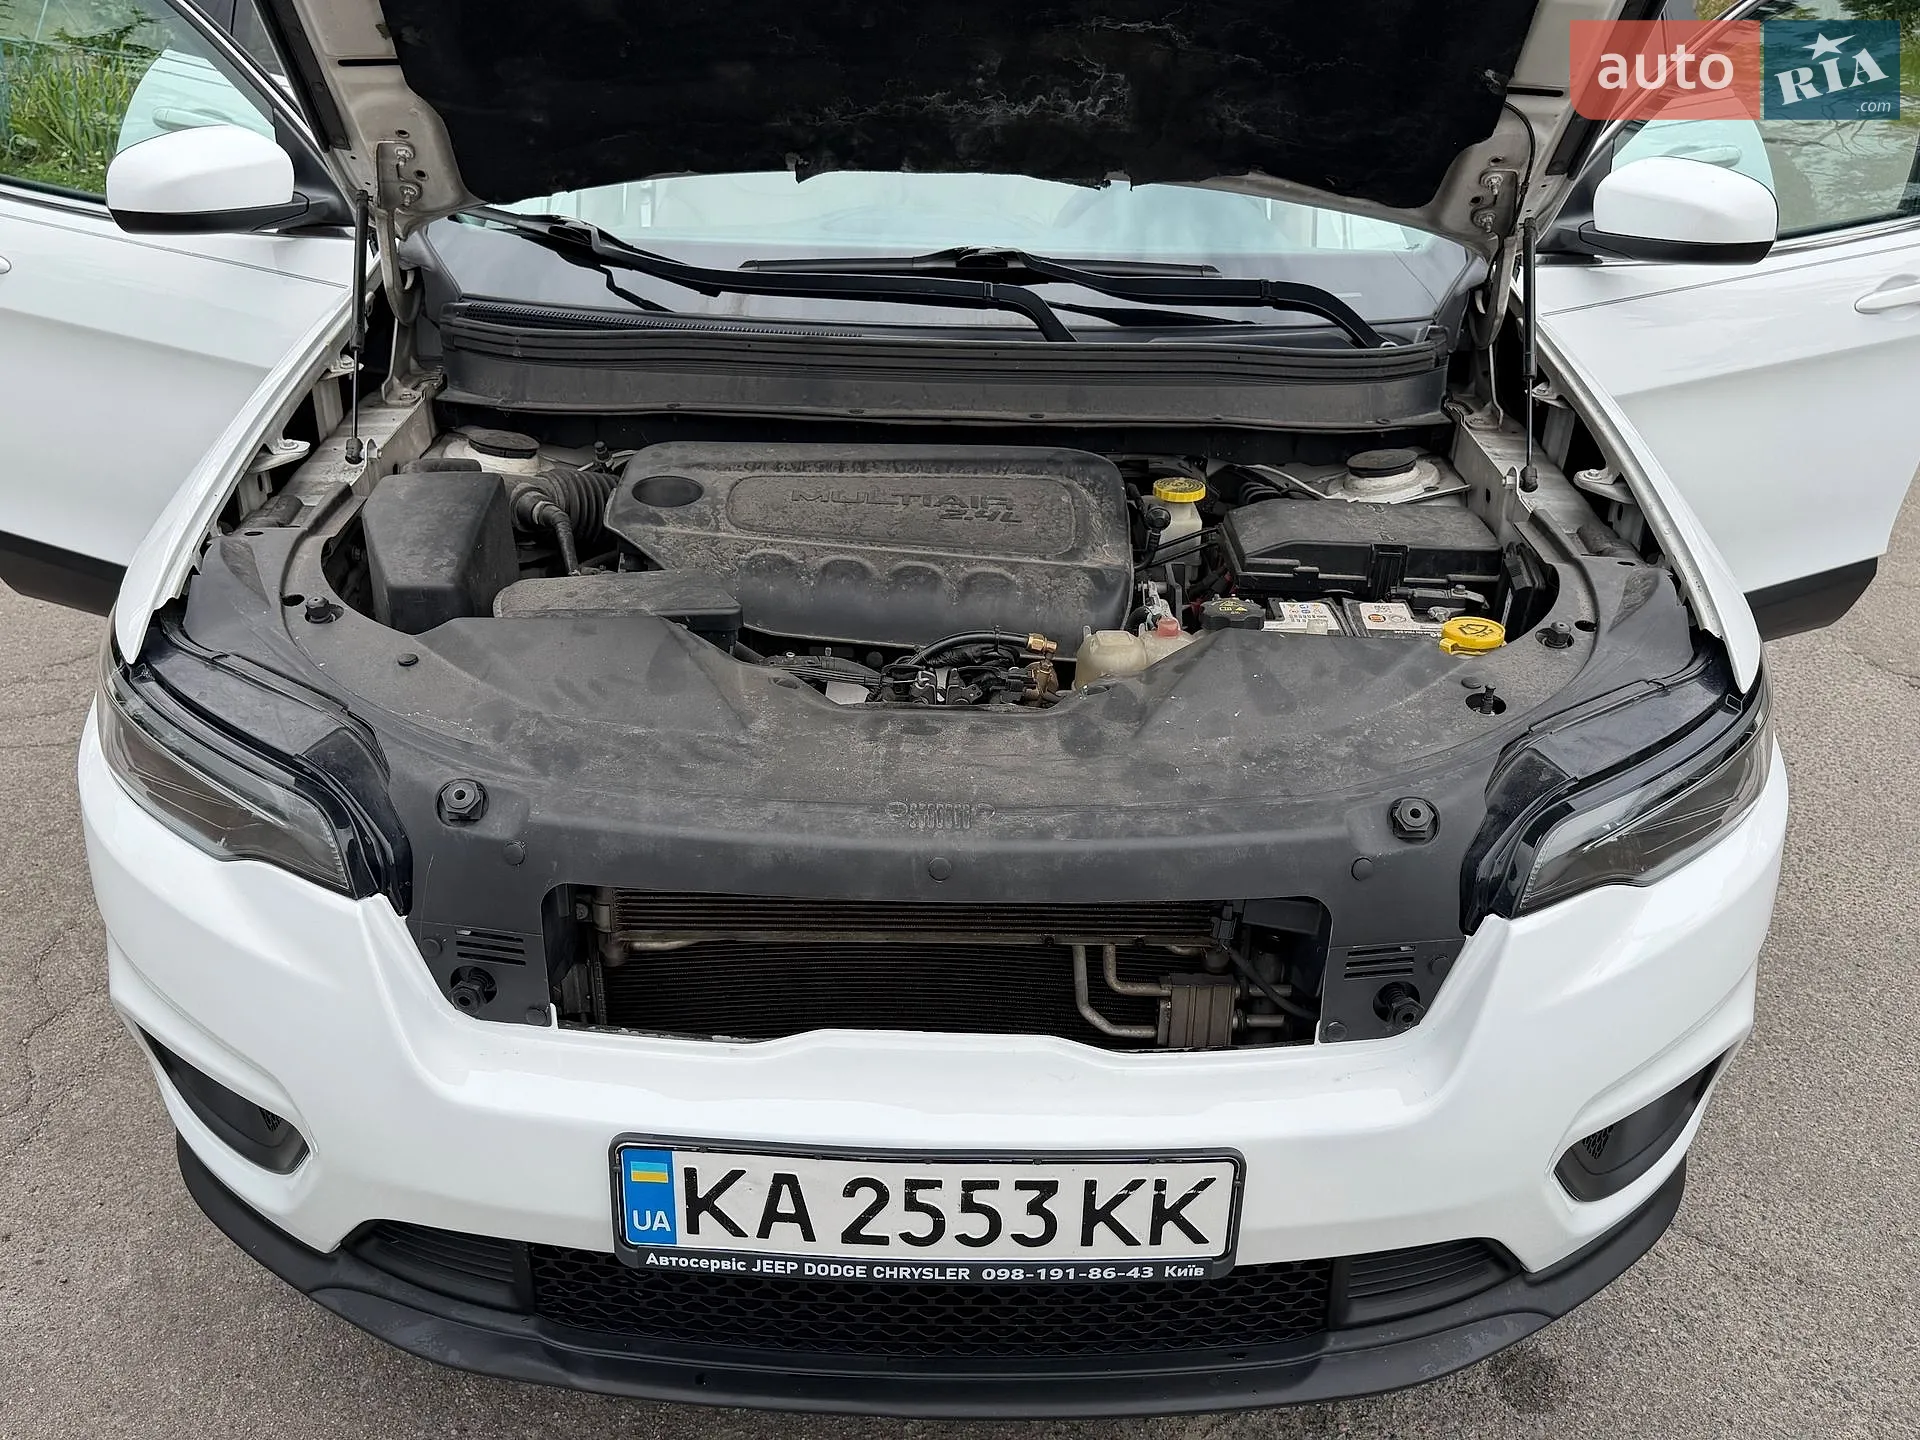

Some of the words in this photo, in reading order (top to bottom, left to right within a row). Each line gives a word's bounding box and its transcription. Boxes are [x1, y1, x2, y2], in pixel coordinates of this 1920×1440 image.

[791, 489, 1013, 510] MULTIAIR
[939, 508, 1022, 523] 2.4L
[632, 1209, 672, 1232] UA
[683, 1167, 817, 1242] KA
[841, 1177, 1059, 1247] 2553
[1080, 1177, 1217, 1246] KK
[646, 1252, 746, 1271] Автосервіс
[752, 1260, 798, 1274] JEEP
[804, 1264, 867, 1278] DODGE
[873, 1266, 970, 1281] CHRYSLER
[981, 1267, 1154, 1281] 098-191-86-43
[1164, 1265, 1205, 1278] Київ
